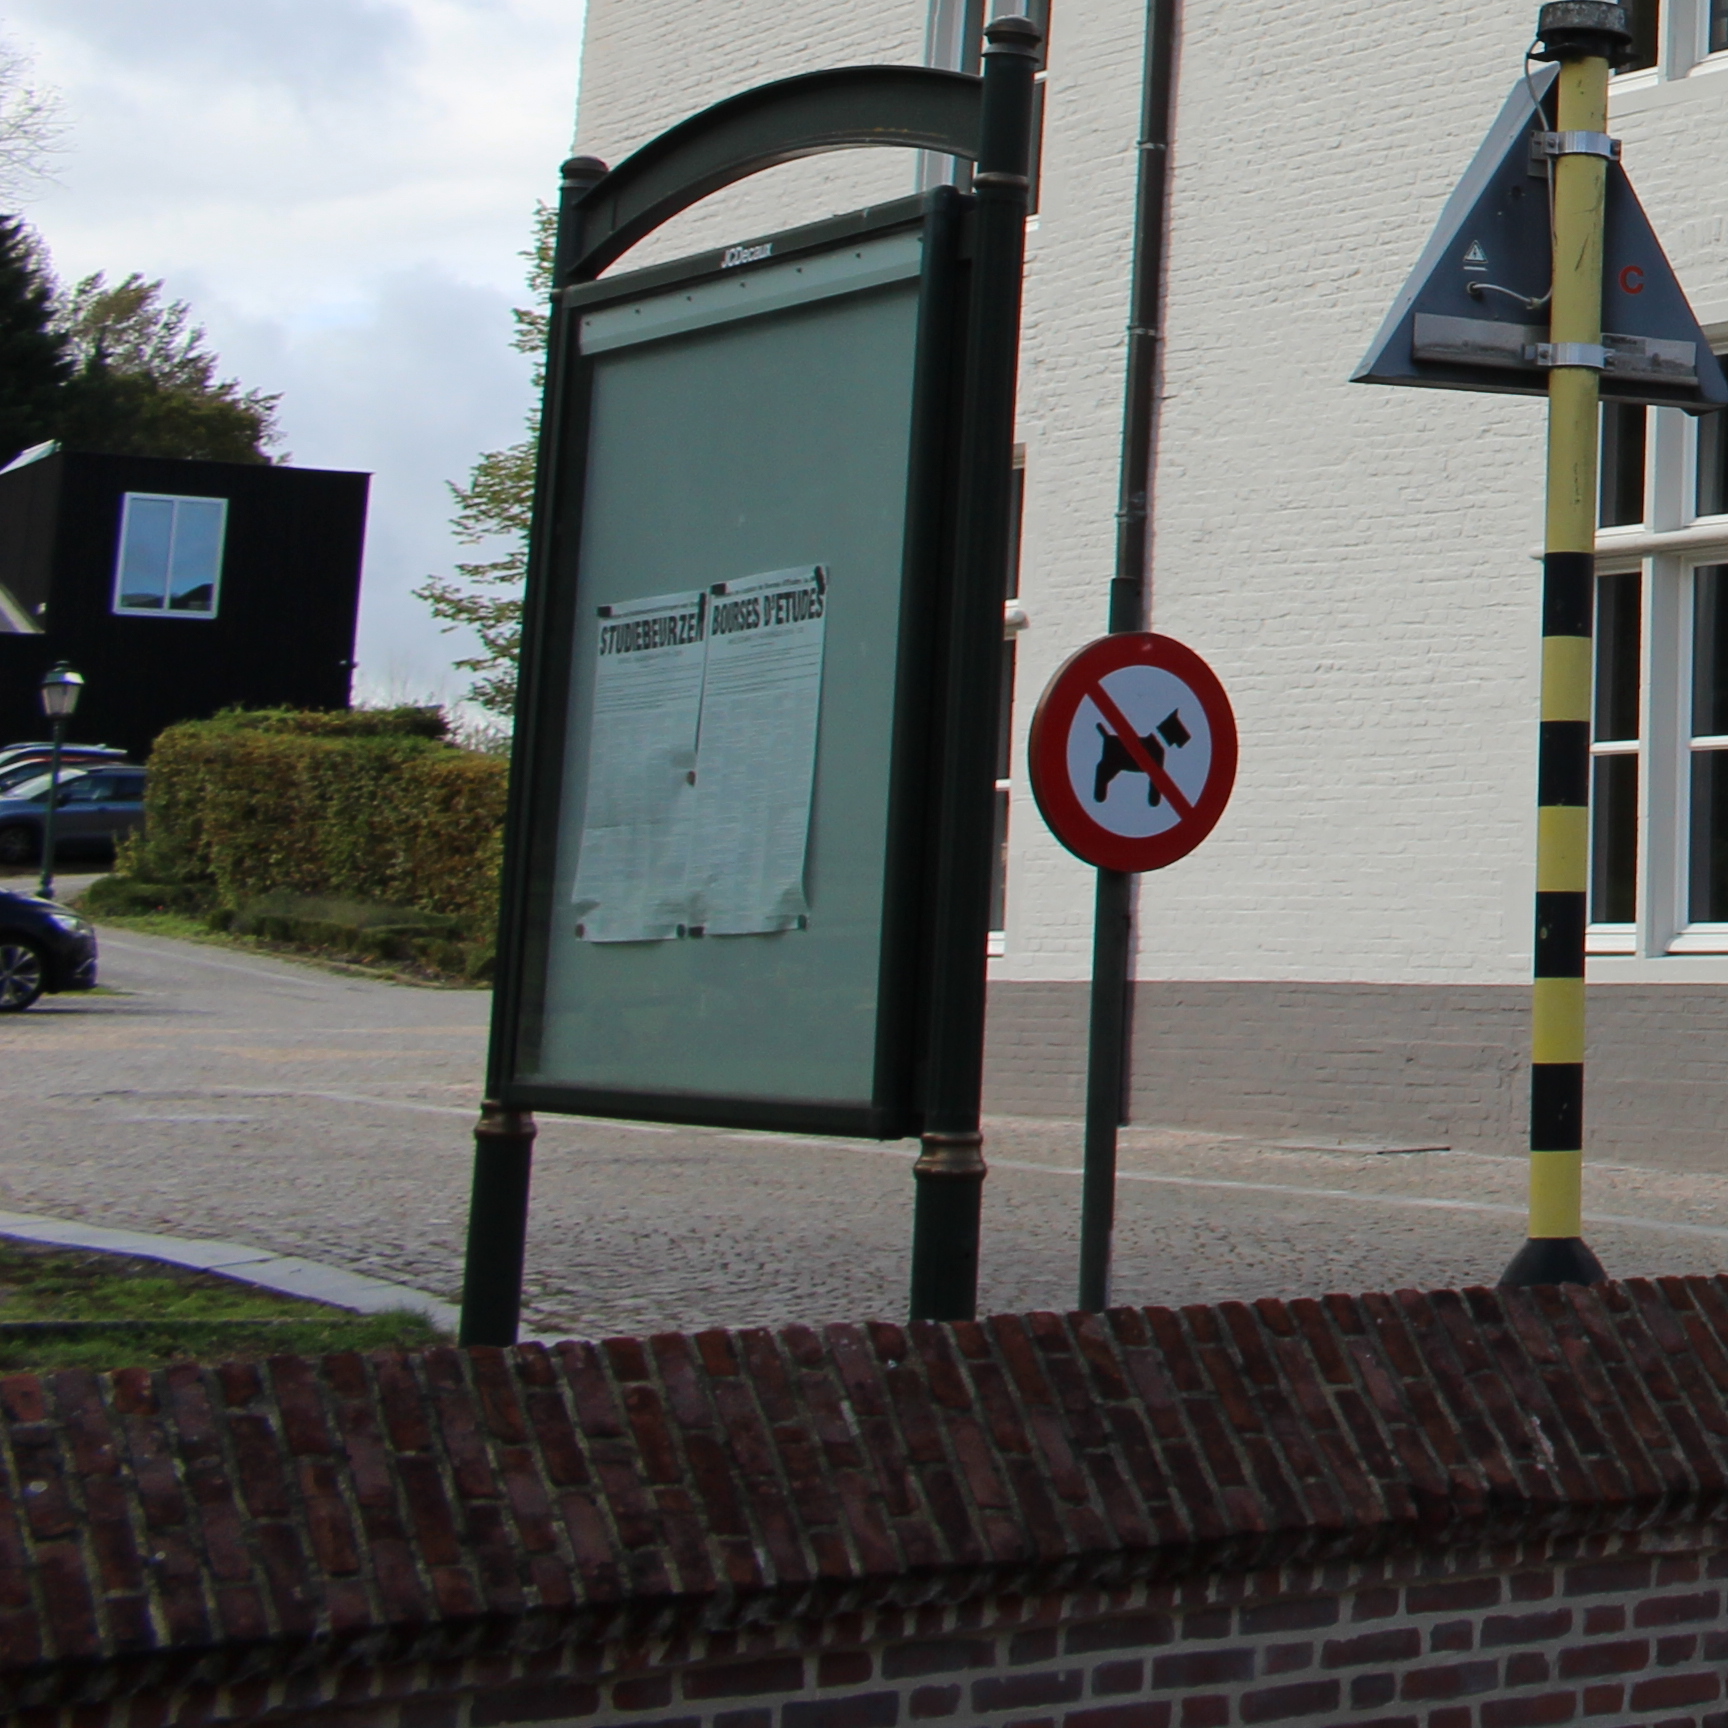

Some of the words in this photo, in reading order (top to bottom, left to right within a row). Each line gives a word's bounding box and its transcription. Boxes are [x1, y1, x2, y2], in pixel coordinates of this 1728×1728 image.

[721, 242, 773, 268] JCDecaux
[1619, 265, 1645, 294] C
[711, 597, 760, 636] BOURSES
[600, 613, 704, 656] STUDIEBEURZEN
